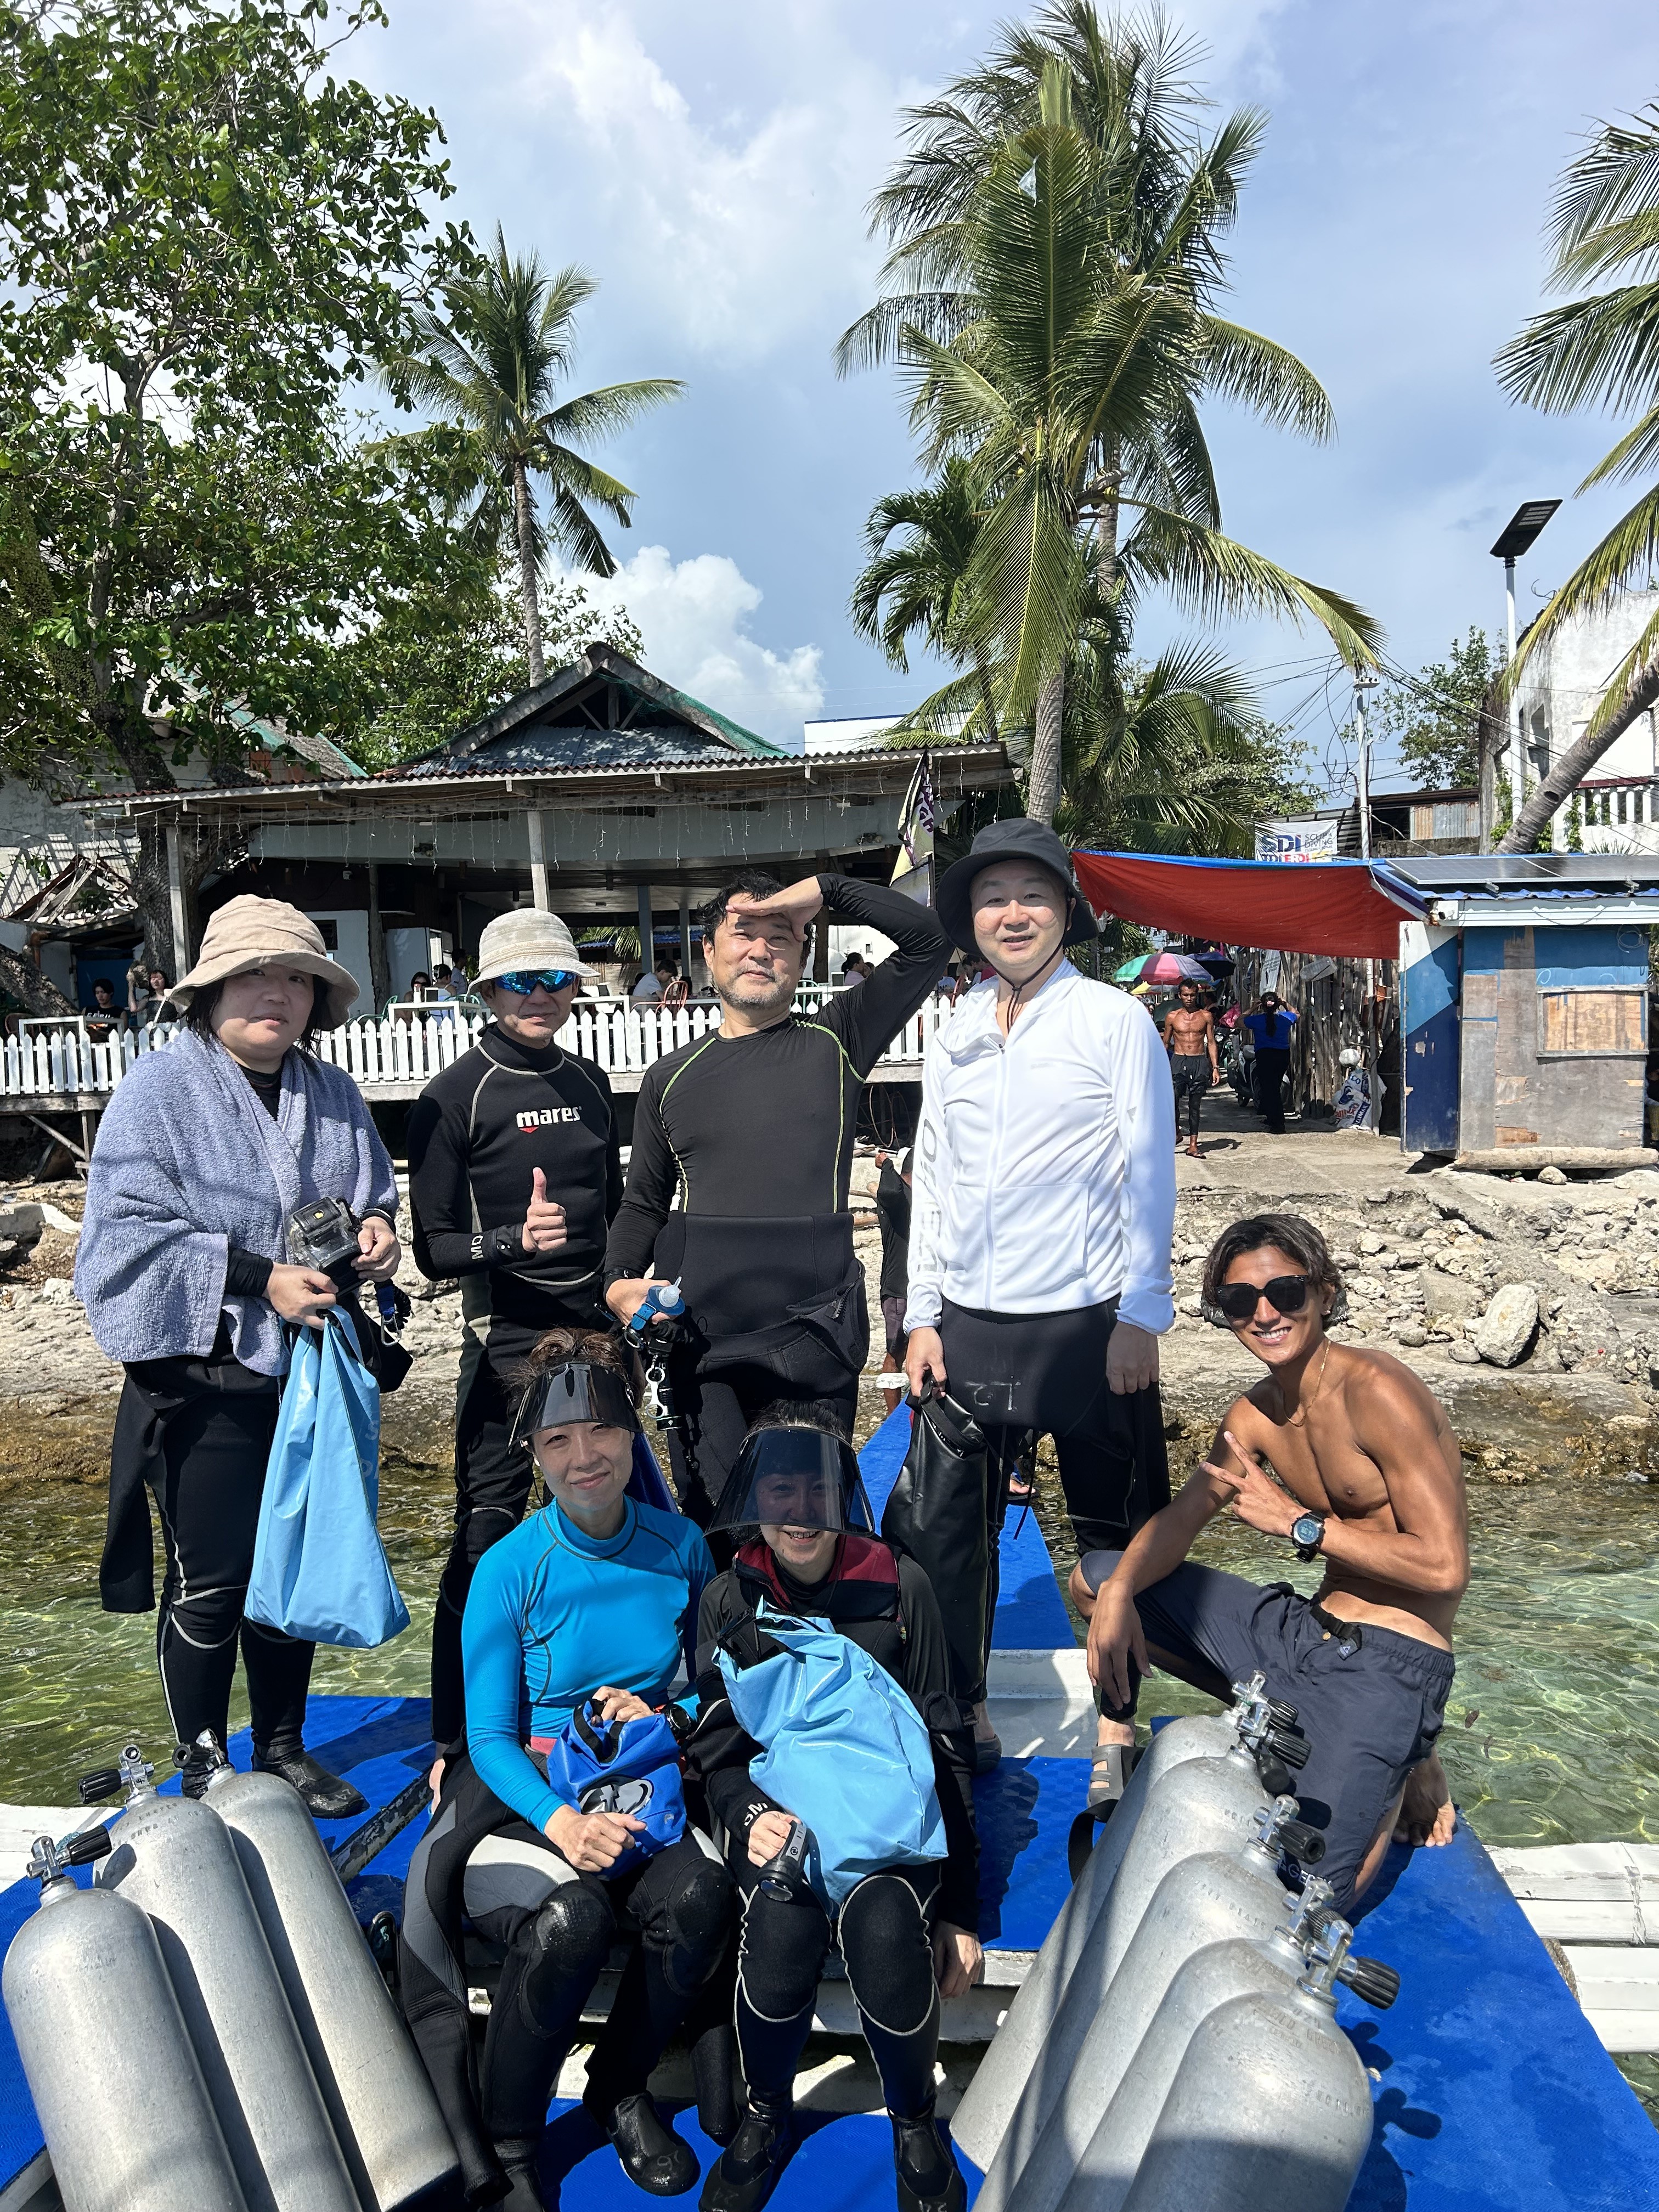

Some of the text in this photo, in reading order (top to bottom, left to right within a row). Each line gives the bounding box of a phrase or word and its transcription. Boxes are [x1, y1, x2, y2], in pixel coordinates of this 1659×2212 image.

[1262, 834, 1301, 853] SDI
[1305, 833, 1333, 841] SCUBA
[1305, 838, 1333, 848] DIVING
[516, 1107, 580, 1127] mares
